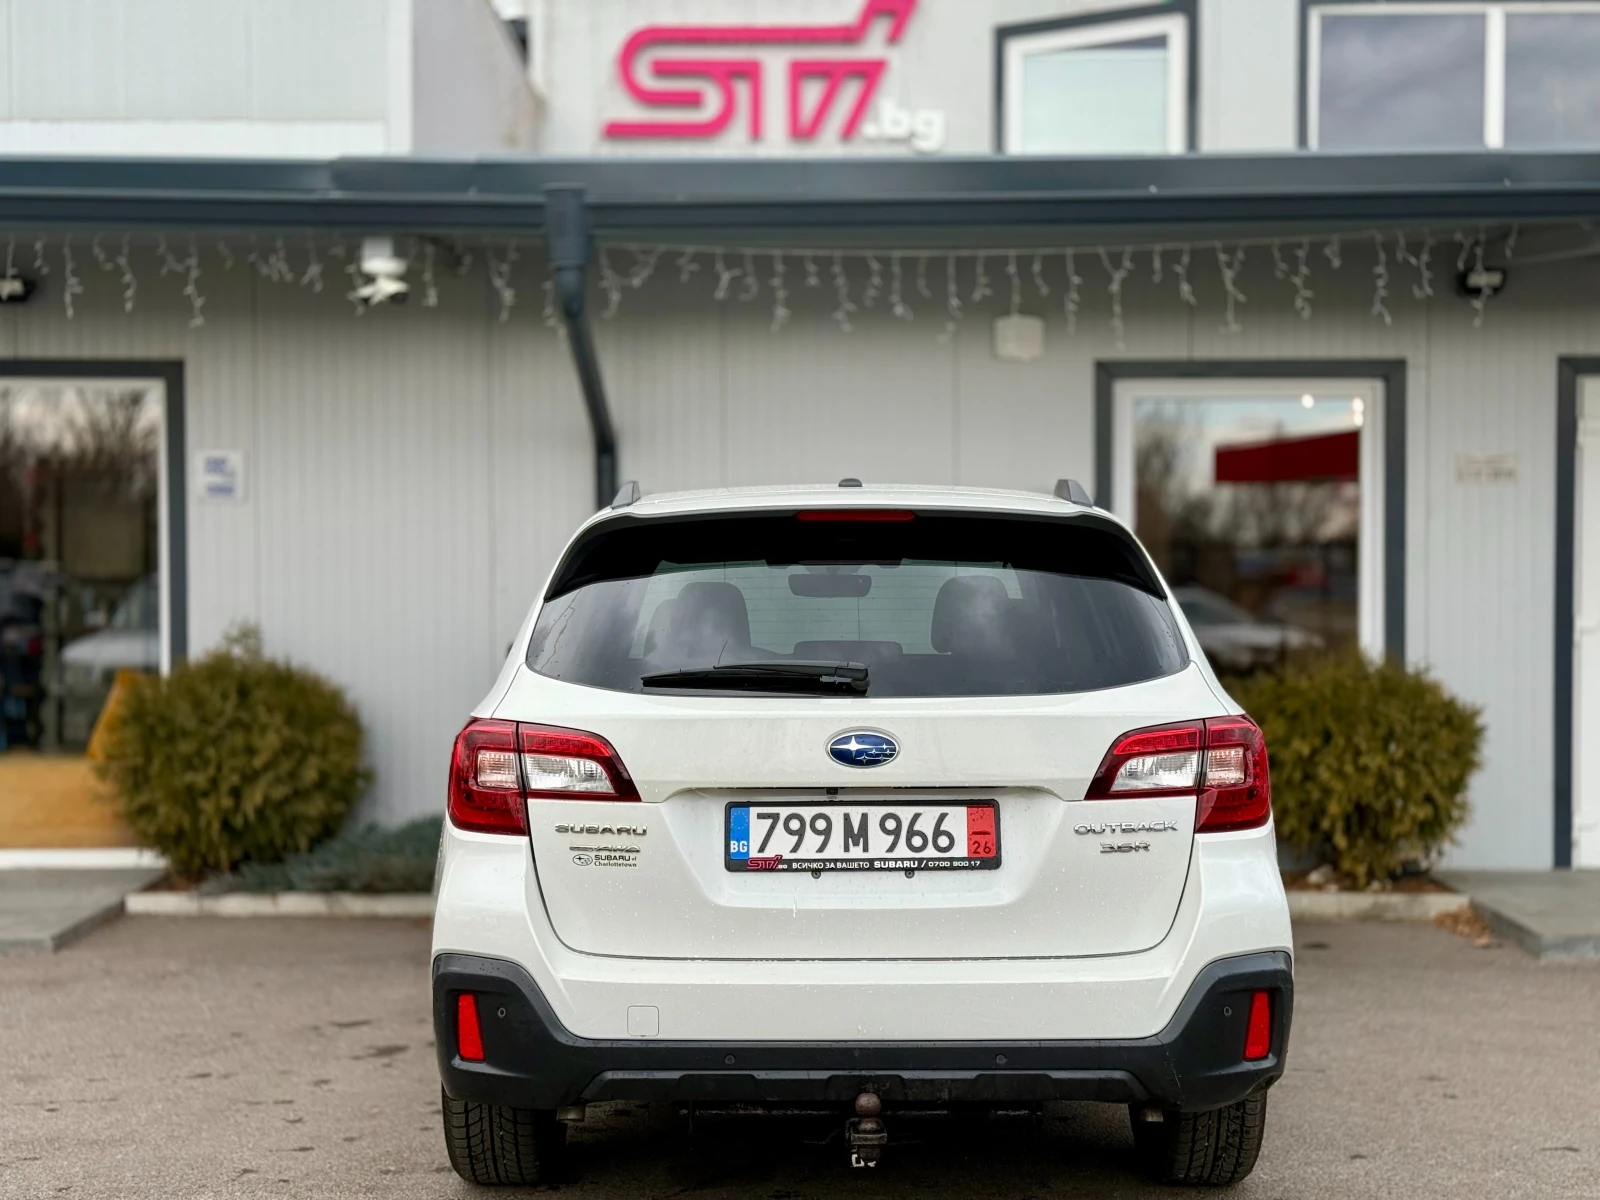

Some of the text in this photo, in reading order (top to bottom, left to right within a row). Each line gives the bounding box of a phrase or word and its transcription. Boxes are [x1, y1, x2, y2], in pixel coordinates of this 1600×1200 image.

[555, 823, 648, 836] SUBARU
[756, 812, 955, 854] 799 M 966
[1073, 820, 1179, 836] OUTBACK
[730, 840, 748, 853] BG
[972, 840, 992, 855] 26
[594, 854, 631, 862] SUBARU
[874, 860, 918, 868] SUBARU
